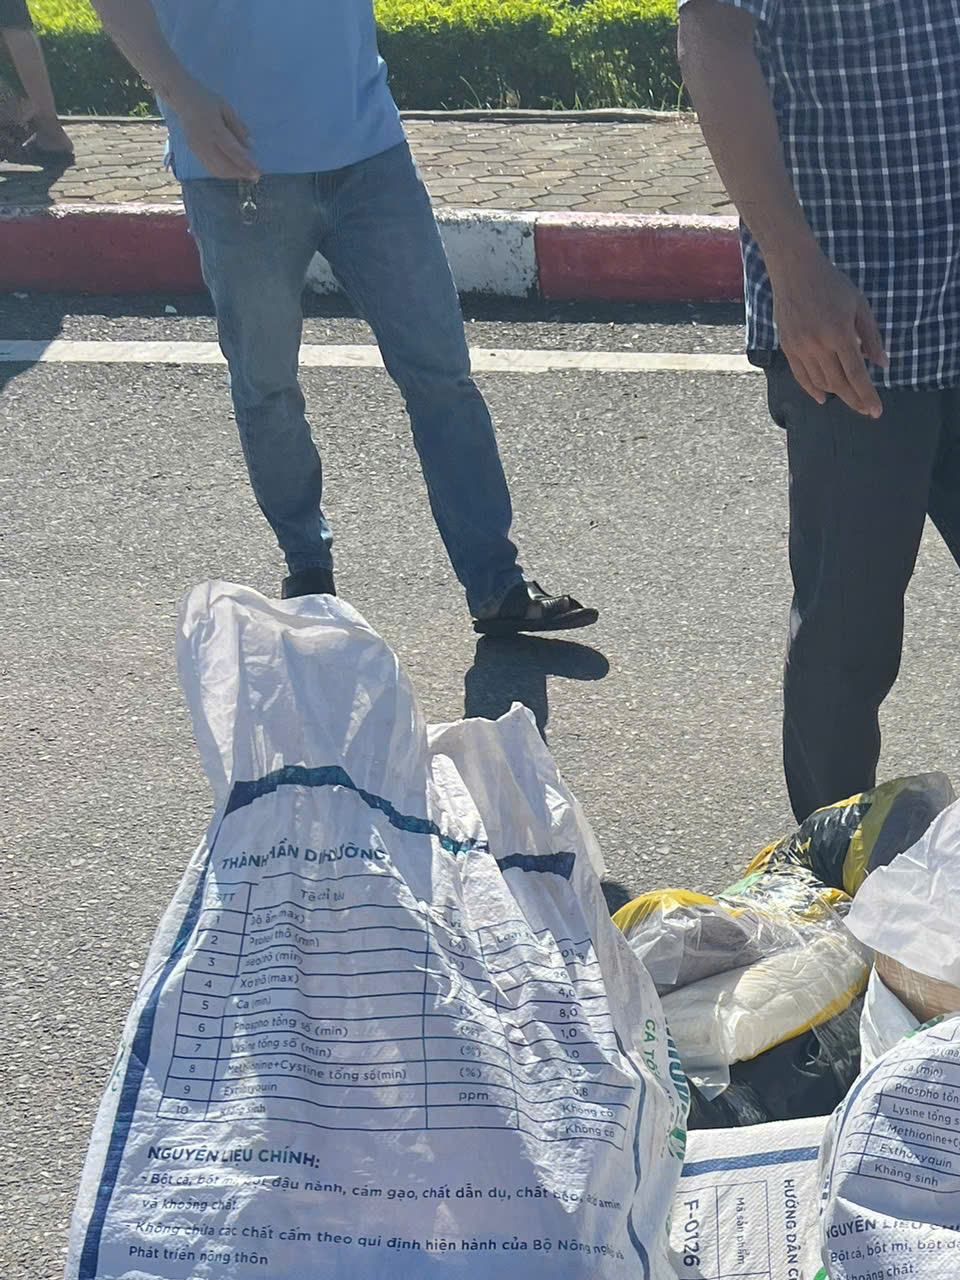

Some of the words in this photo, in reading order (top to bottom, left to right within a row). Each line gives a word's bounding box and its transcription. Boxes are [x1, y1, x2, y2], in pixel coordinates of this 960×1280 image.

[458, 1090, 489, 1102] ppm
[147, 1142, 218, 1162] NGUYÊN
[221, 1146, 252, 1167] LIỆU
[258, 1144, 320, 1169] CHÍNH:
